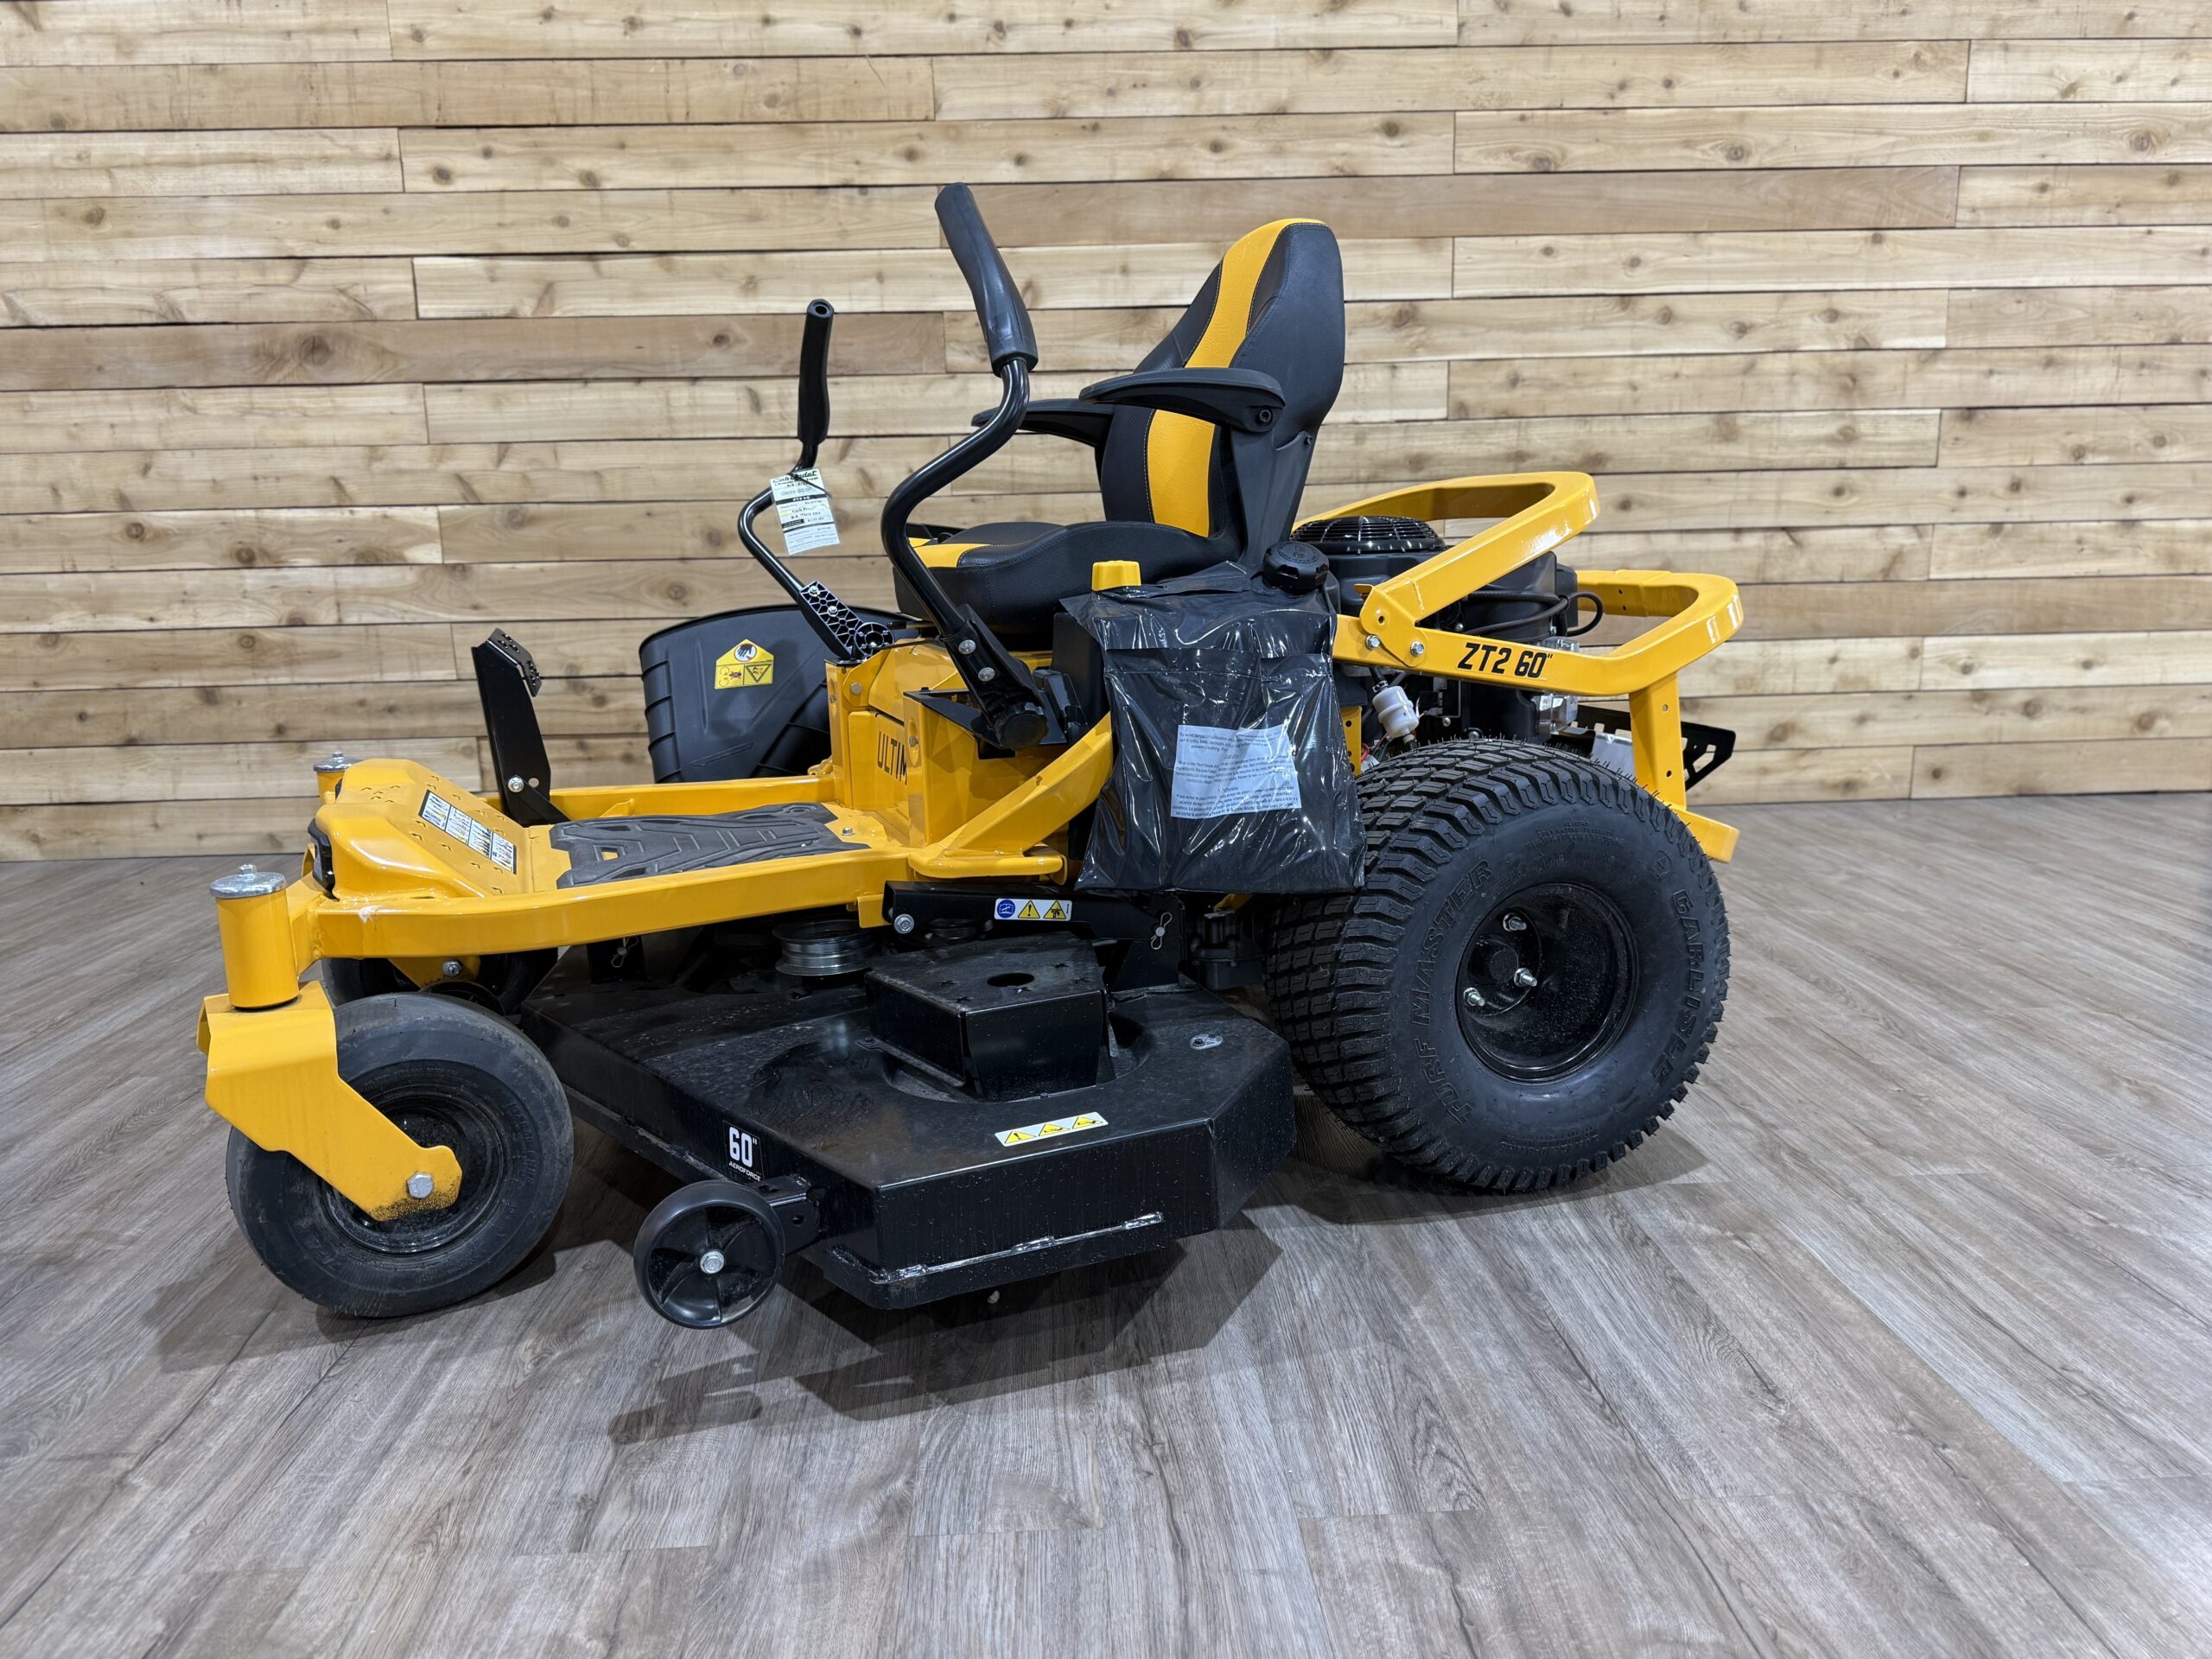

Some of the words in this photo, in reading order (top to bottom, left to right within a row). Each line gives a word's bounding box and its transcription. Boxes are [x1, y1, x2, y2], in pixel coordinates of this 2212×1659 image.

[1458, 642, 1512, 674] ZT2
[1411, 859, 1492, 1027] MASTER
[1651, 888, 1705, 1085] CARLISLE
[1414, 1038, 1473, 1124] TURF
[728, 1161, 761, 1182] AEROFORCE
[729, 1126, 758, 1168] 60"
